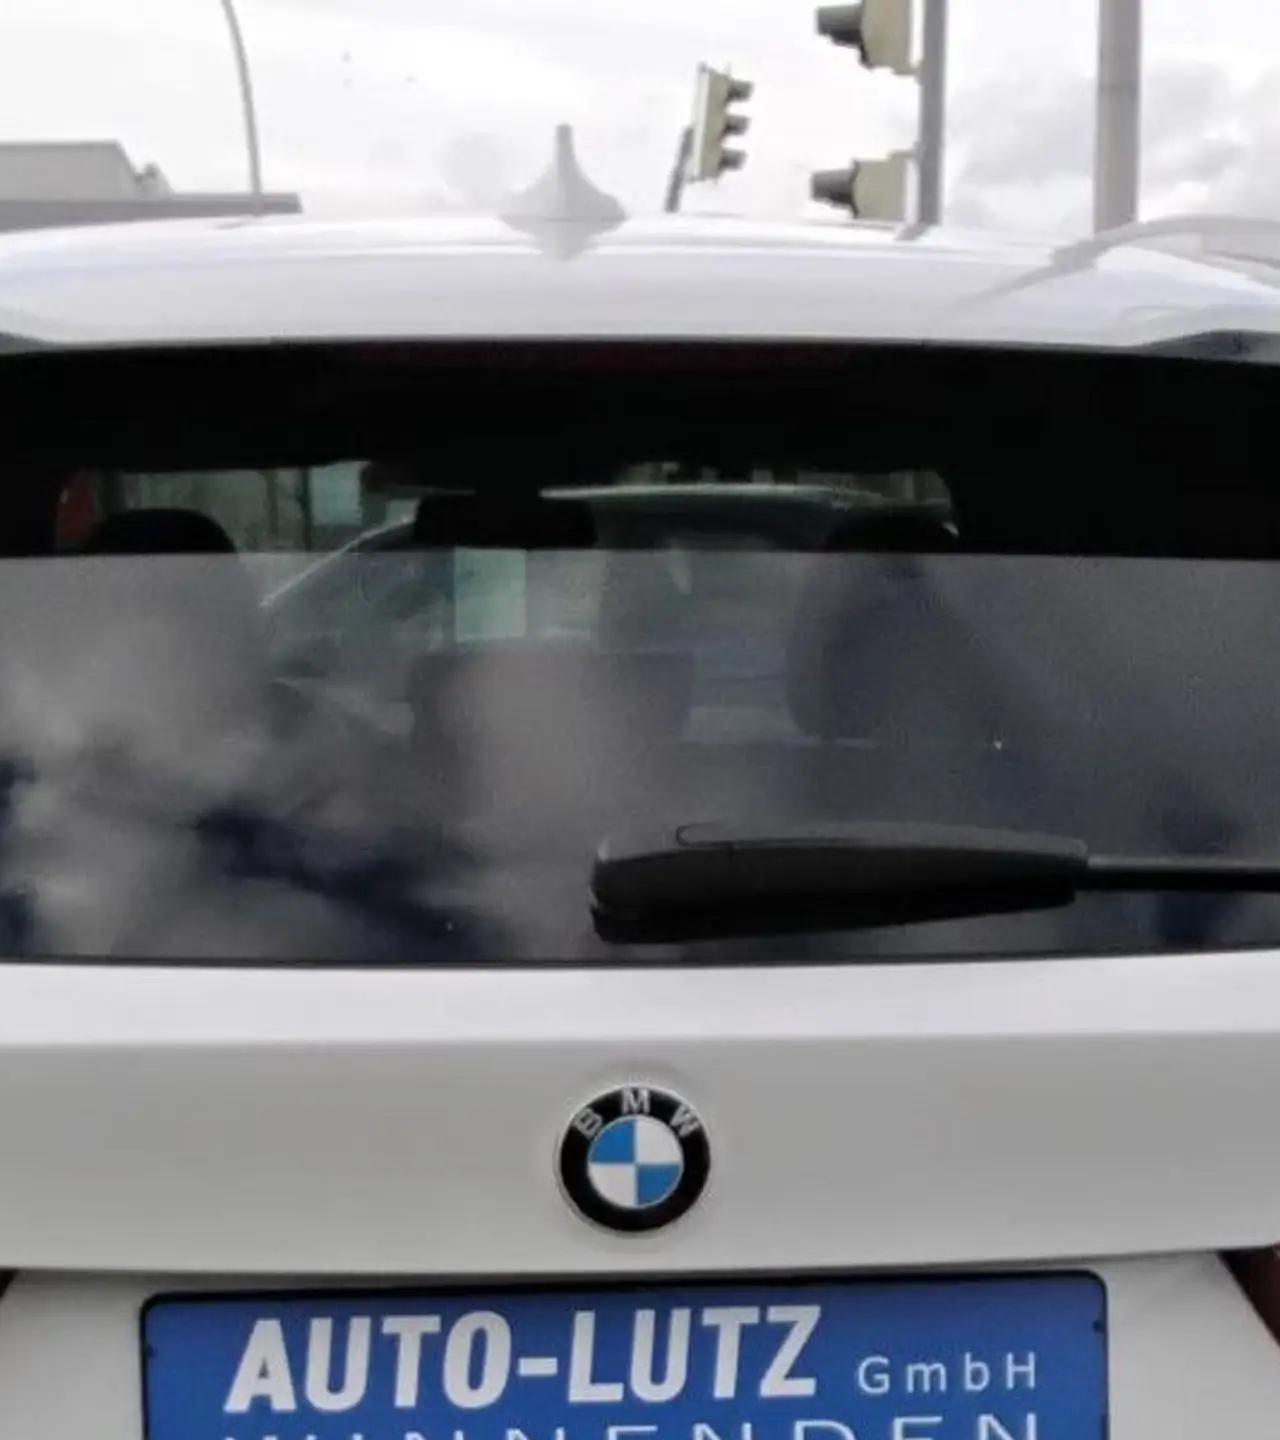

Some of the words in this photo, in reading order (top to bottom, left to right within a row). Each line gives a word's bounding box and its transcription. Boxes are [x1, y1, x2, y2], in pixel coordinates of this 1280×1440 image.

[572, 1086, 702, 1139] BMW
[223, 1305, 821, 1413] AUTO-LUTZ
[857, 1352, 1037, 1394] GmbH
